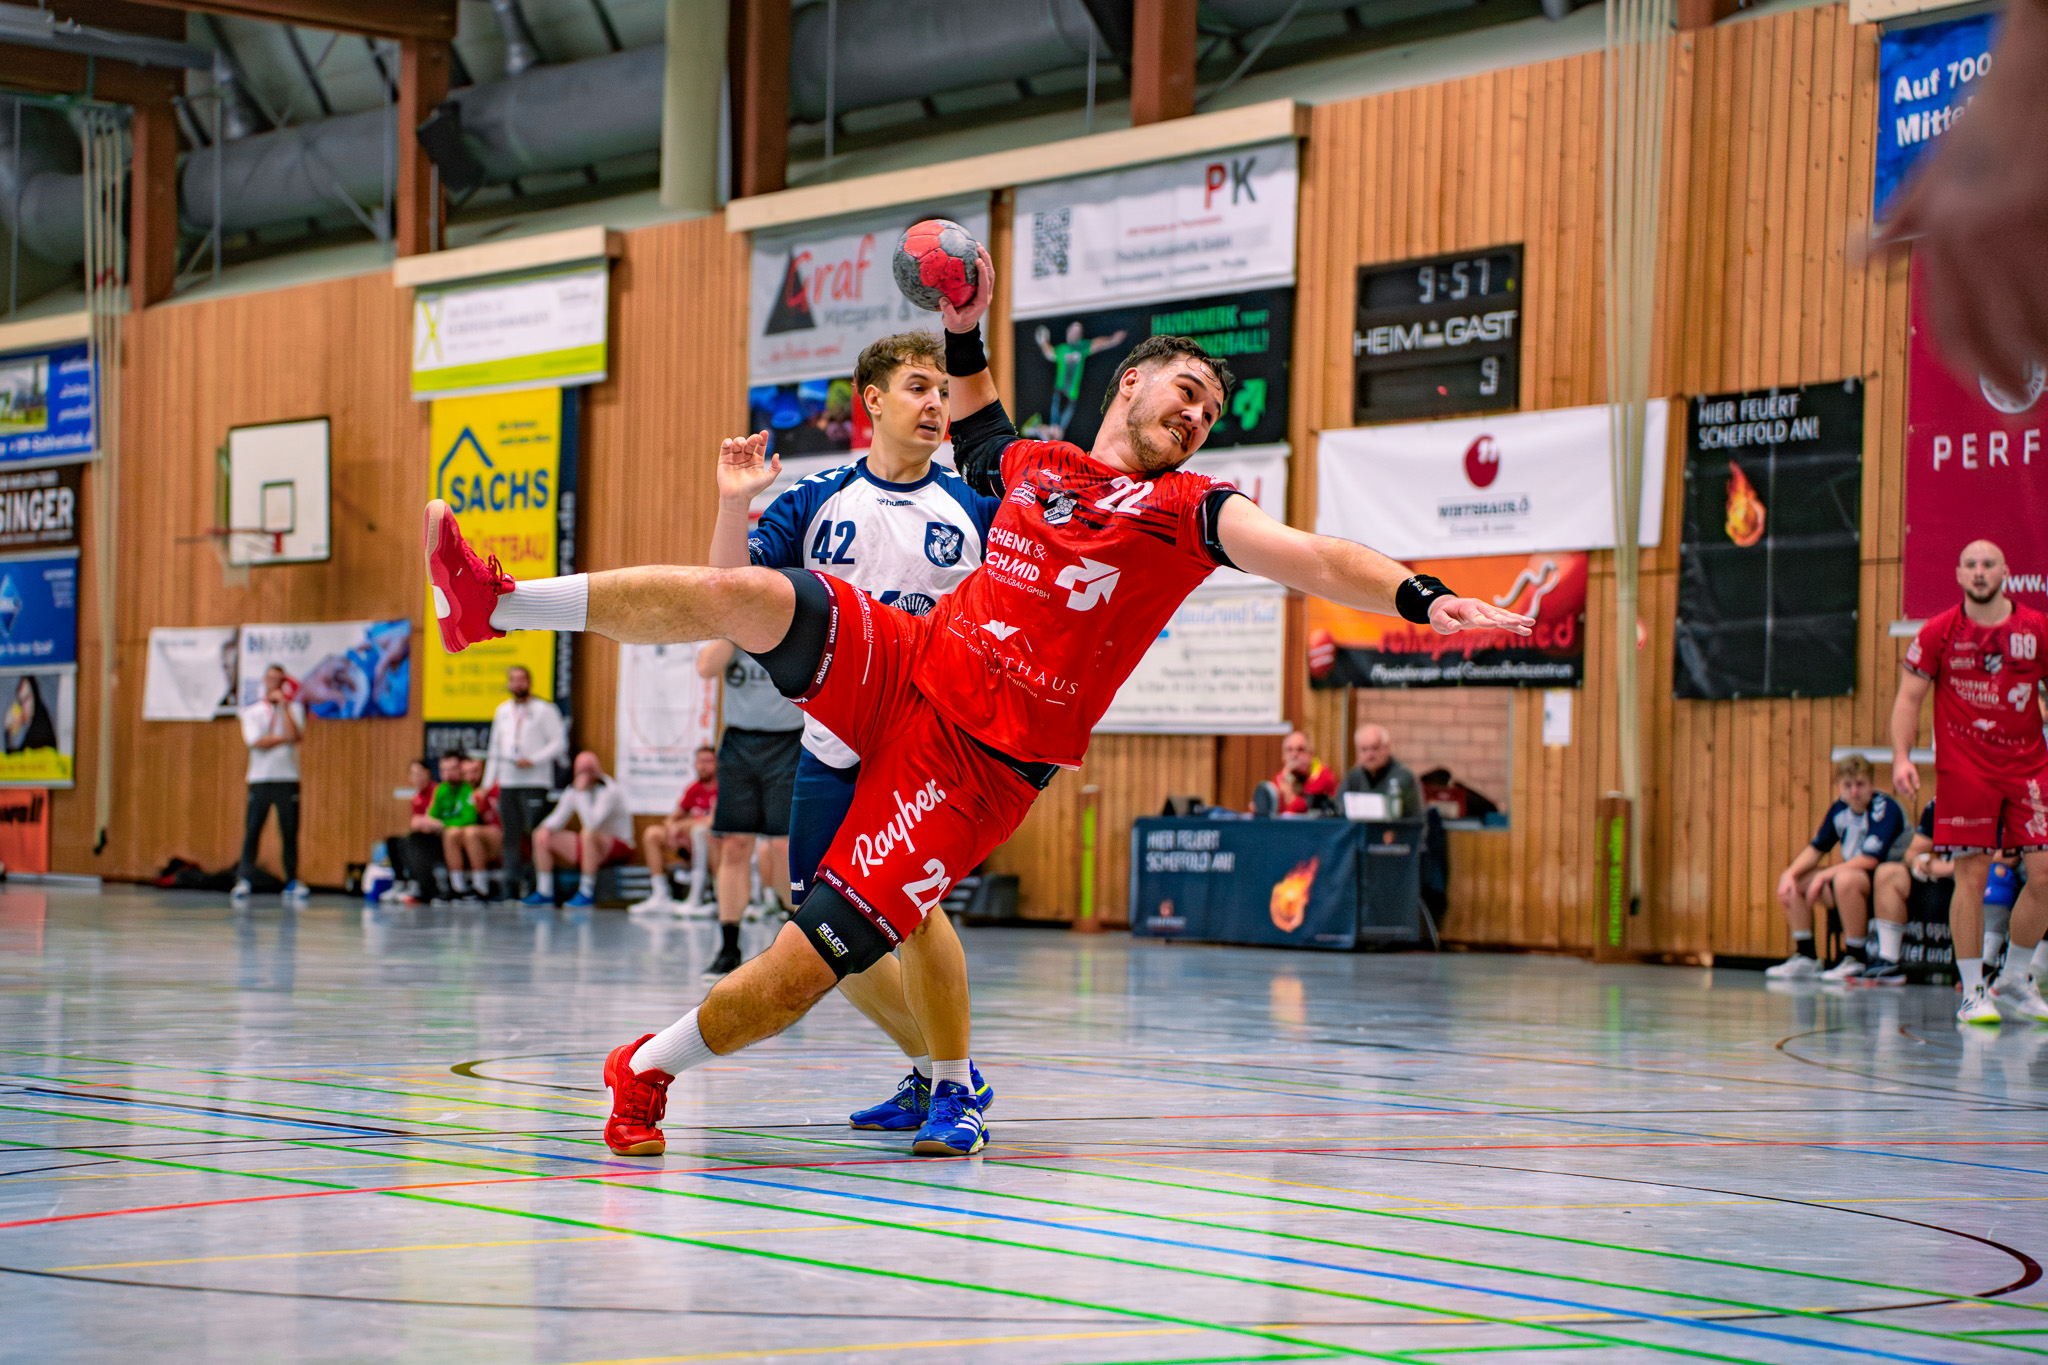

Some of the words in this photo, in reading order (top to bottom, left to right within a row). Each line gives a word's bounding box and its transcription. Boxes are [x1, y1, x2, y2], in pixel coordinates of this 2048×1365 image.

[1894, 68, 1941, 104] Auf
[1947, 52, 1993, 89] 700
[1896, 96, 1975, 147] Mitte
[1205, 157, 1256, 209] PK
[786, 233, 875, 313] Graf
[1418, 258, 1491, 304] 9:57
[1354, 322, 1424, 357] HEIM
[1445, 310, 1518, 346] GAST
[1479, 356, 1499, 396] 9
[1698, 400, 1736, 425] HIER
[1740, 393, 1800, 421] FEUERT
[1698, 420, 1788, 450] SCHEFFOLD
[1790, 416, 1820, 441] AN!
[1933, 429, 2040, 472] PERF
[450, 469, 549, 514] SACHS
[1094, 476, 1154, 516] 22
[811, 520, 857, 565] 42
[987, 527, 1034, 557] CHENK
[1033, 544, 1048, 561] &
[986, 548, 1040, 582] CHMID
[1026, 585, 1051, 600] GMBH
[2002, 573, 2048, 597] ww.
[829, 605, 839, 644] Kempa
[815, 652, 833, 685] Kempa
[845, 886, 873, 914] Kempa
[818, 922, 849, 956] SELECT
[876, 915, 899, 942] Kempa
